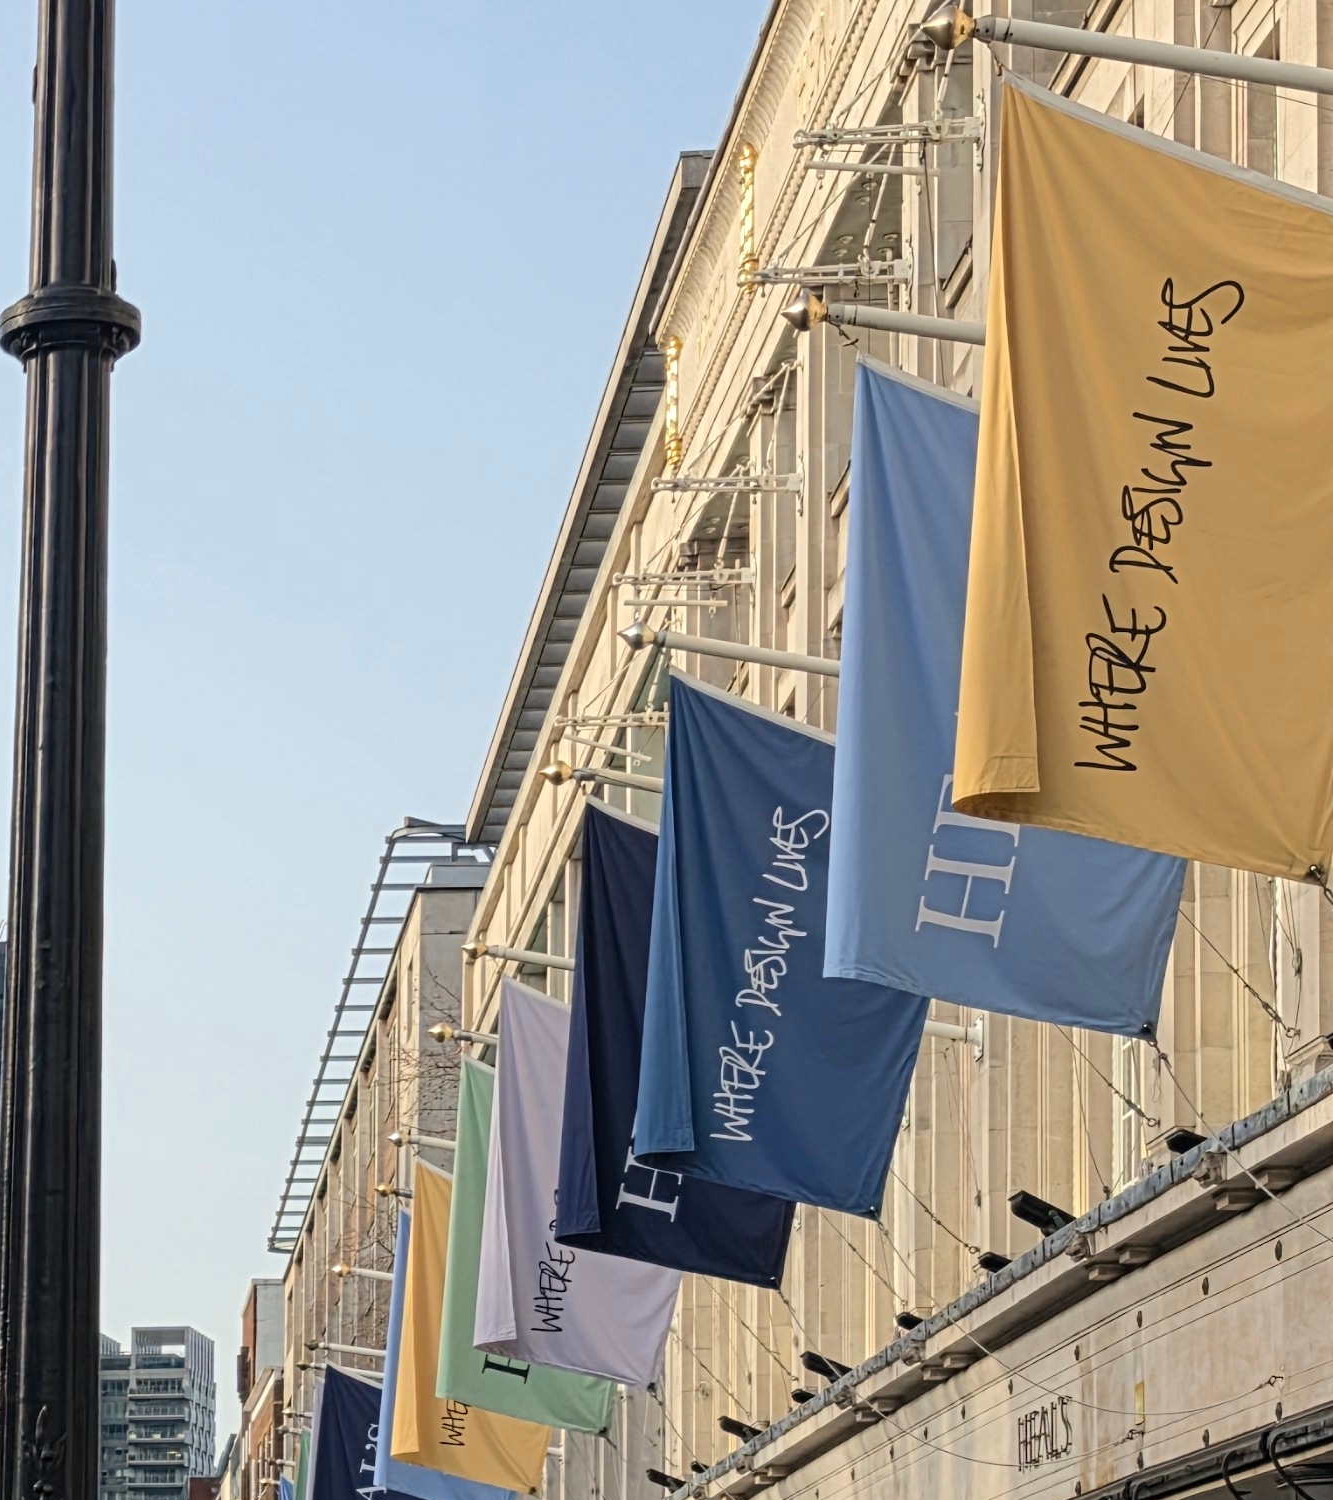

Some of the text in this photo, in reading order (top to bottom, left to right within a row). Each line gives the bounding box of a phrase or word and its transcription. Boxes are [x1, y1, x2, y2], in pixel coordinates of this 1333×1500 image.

[1074, 277, 1245, 771] WHERE DESIGN LIVES
[709, 806, 830, 1142] WHERE DESIGN LIVES
[530, 1241, 576, 1332] WHERE
